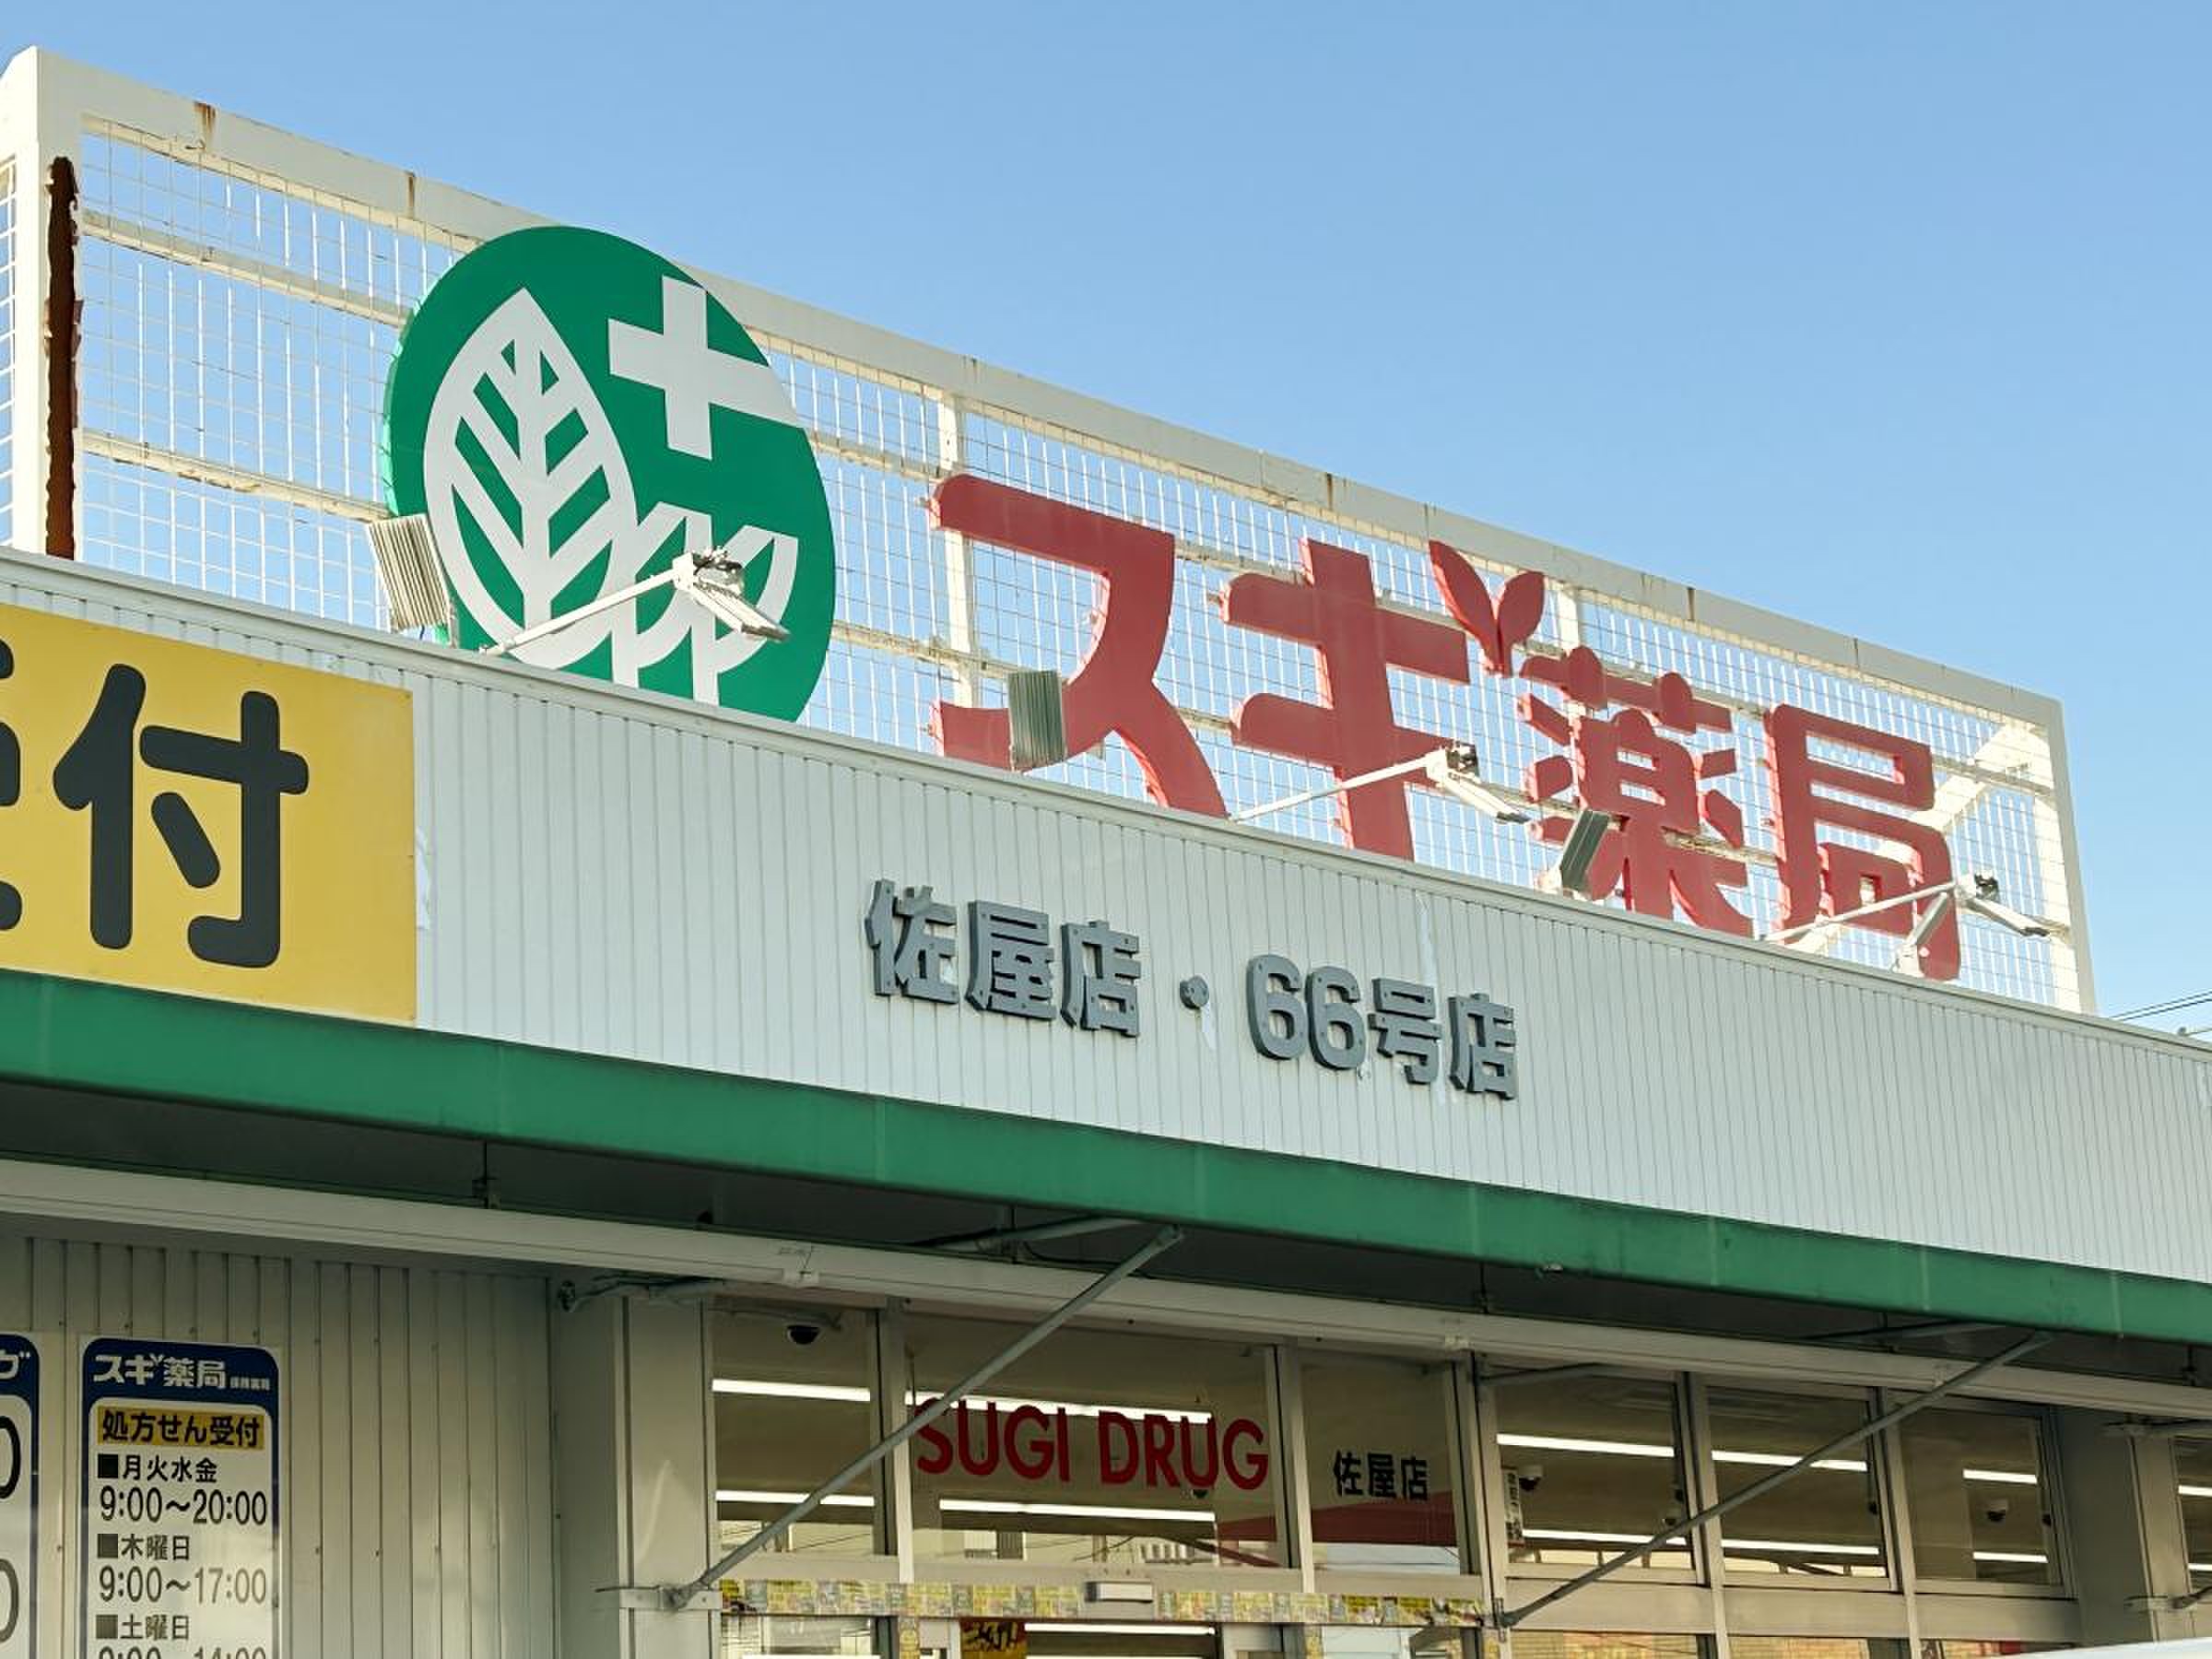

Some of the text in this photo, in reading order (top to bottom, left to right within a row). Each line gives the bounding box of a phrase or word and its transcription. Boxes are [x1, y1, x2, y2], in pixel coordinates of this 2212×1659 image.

[929, 473, 1961, 981] スギ薬局
[93, 1354, 226, 1390] スギ薬局
[102, 1410, 260, 1448] 処方せん受付
[916, 1397, 1269, 1490] SUGI DRUG
[123, 1454, 218, 1483] 月火水金
[1332, 1449, 1428, 1501] 佐屋店
[121, 1533, 190, 1561] 木曜日
[120, 1614, 190, 1641] 土曜日
